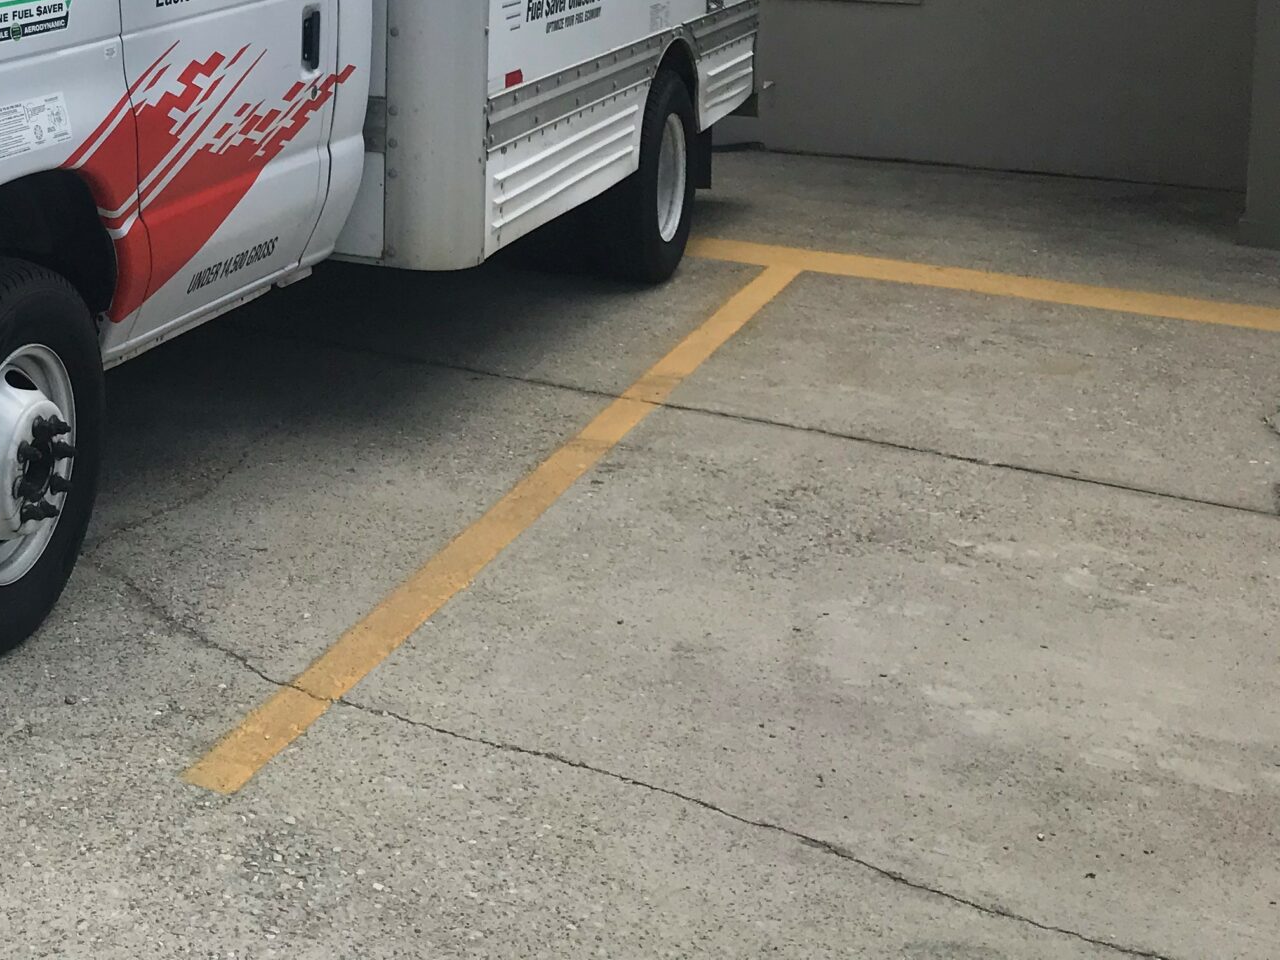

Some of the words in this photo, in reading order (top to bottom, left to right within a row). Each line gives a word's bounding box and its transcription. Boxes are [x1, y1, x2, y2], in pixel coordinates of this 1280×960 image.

[12, 8, 34, 21] FUEL
[24, 19, 66, 34] AERODYNAMIC
[186, 261, 222, 294] UNDER
[246, 236, 279, 267] GROSS
